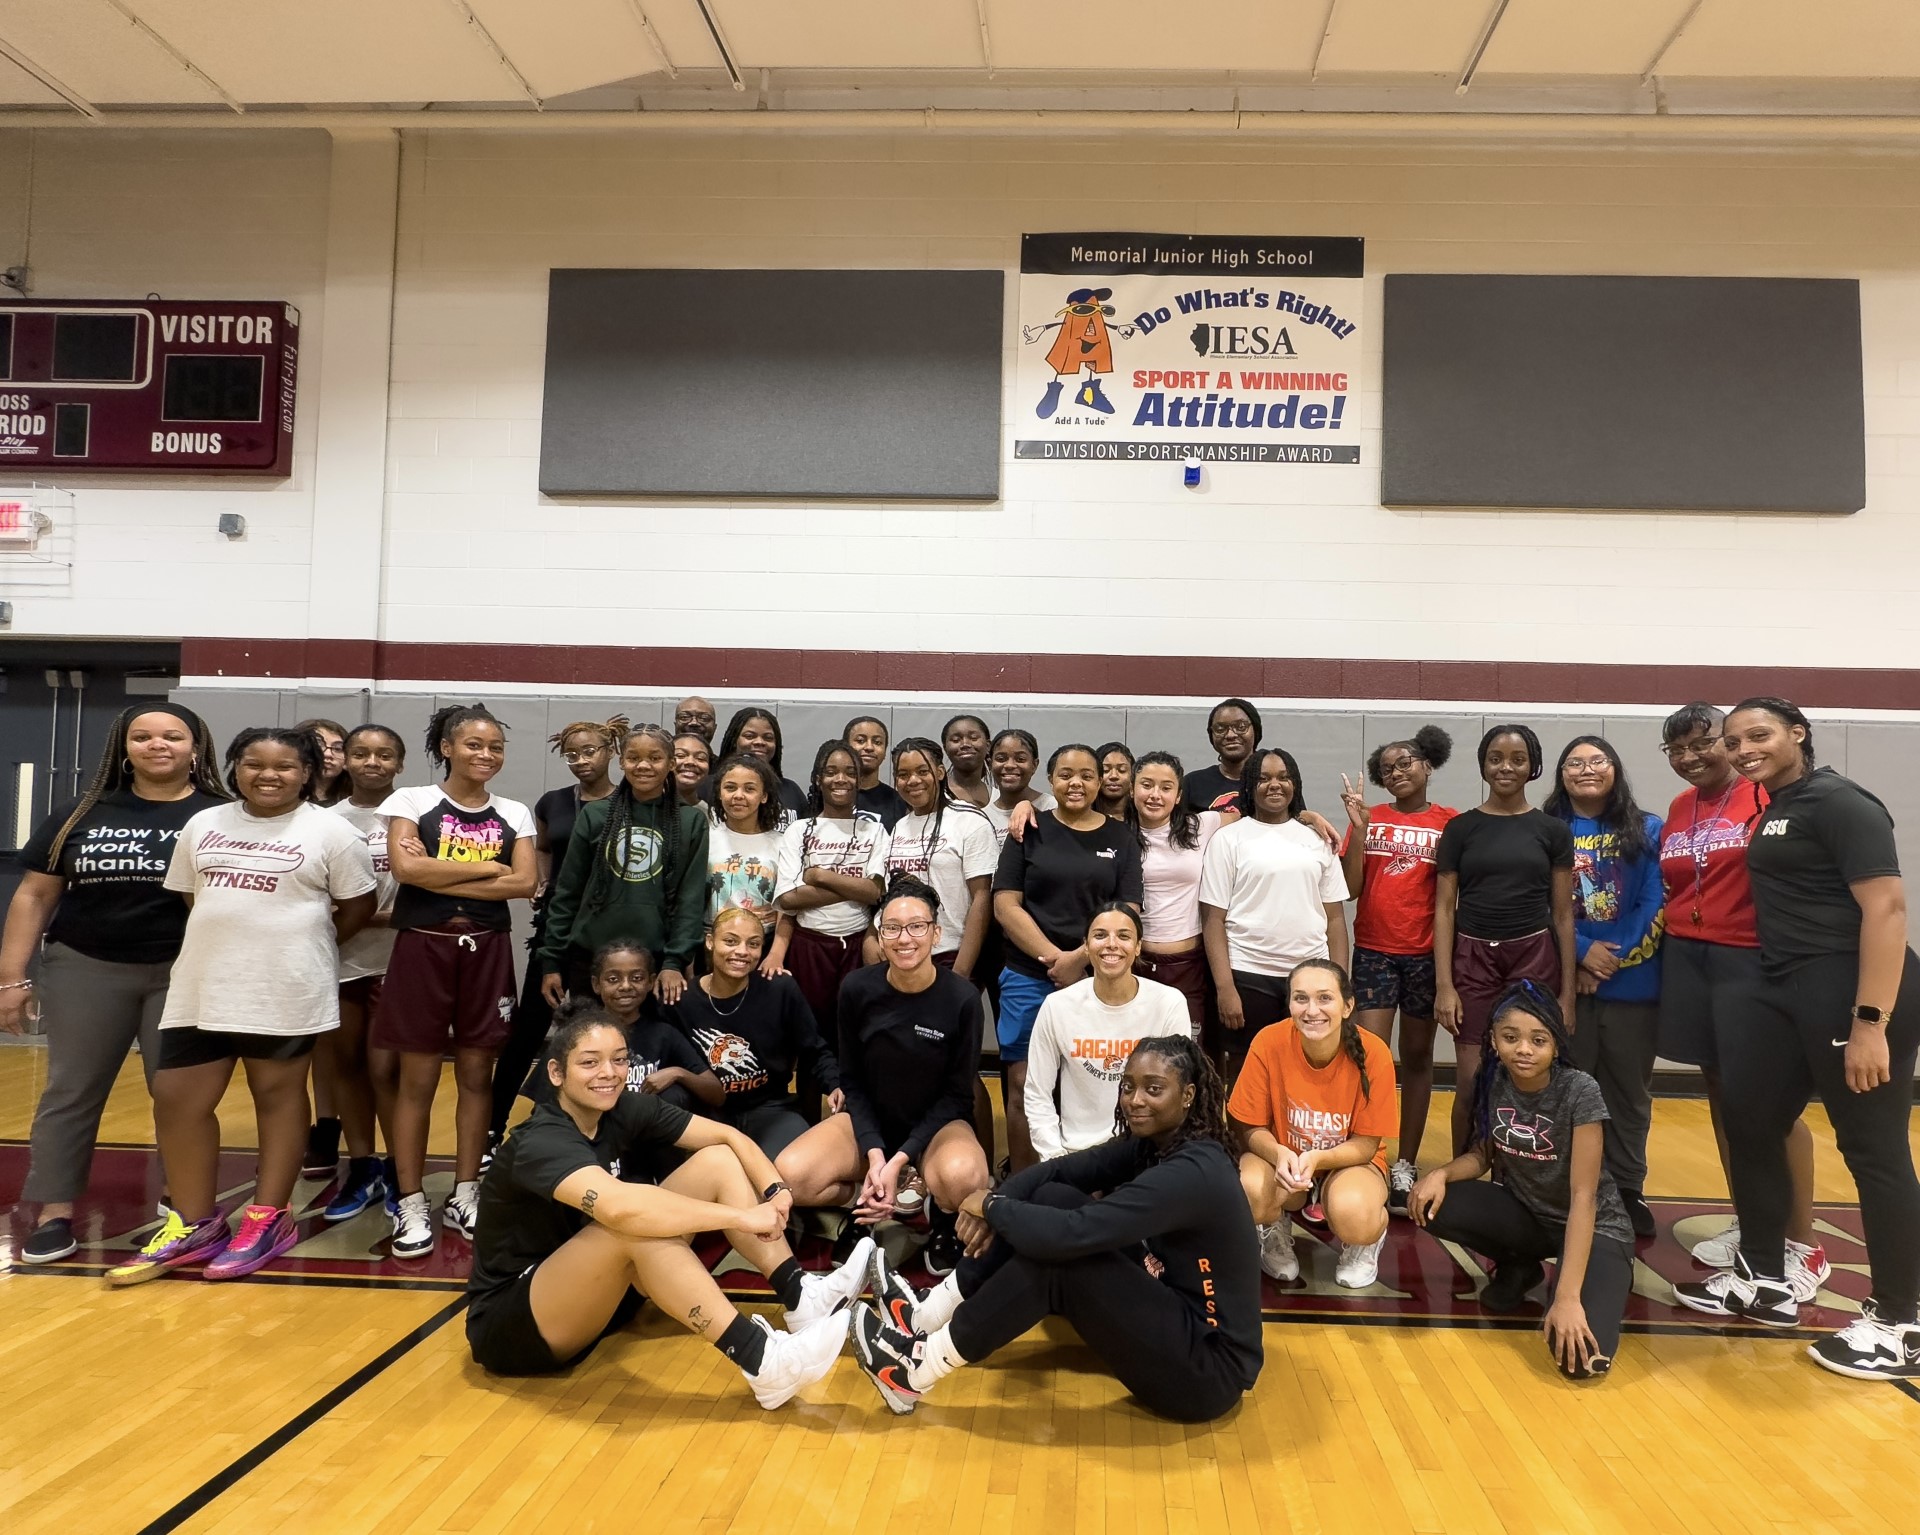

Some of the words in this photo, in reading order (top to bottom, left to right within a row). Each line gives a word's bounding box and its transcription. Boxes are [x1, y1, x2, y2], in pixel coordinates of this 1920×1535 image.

[1070, 246, 1147, 263] Memorial
[1153, 247, 1205, 264] Junior
[1211, 248, 1249, 268] High
[1256, 249, 1313, 265] School
[1133, 306, 1172, 336] Do
[1174, 287, 1270, 315] What's
[1275, 290, 1357, 341] Right!
[160, 315, 273, 344] VISITOR
[1210, 326, 1298, 356] IESA
[281, 343, 297, 433] fair-play.com
[1132, 370, 1210, 389] SPORT
[1216, 371, 1233, 390] A
[1239, 371, 1348, 392] WINNING
[1054, 416, 1072, 425] Add
[1074, 417, 1081, 425] A
[1132, 392, 1347, 430] Attitude!
[151, 432, 222, 453] BONUS
[1043, 443, 1118, 458] DIVISION
[1127, 444, 1268, 461] SPORTSMANSHIP
[1276, 447, 1333, 463] AWARD
[87, 825, 152, 839] show
[1762, 819, 1789, 836] GSU
[81, 840, 151, 855] work,
[197, 830, 302, 855] Memorial
[1392, 828, 1442, 849] SOUT
[75, 856, 166, 872] thanks
[622, 871, 650, 879] thletics
[1070, 1039, 1140, 1059] JAGUA
[722, 1074, 768, 1093] LETICS
[1287, 1107, 1352, 1132] UNLEASH
[1286, 1130, 1307, 1152] THE
[1518, 1150, 1557, 1161] ARMOUR
